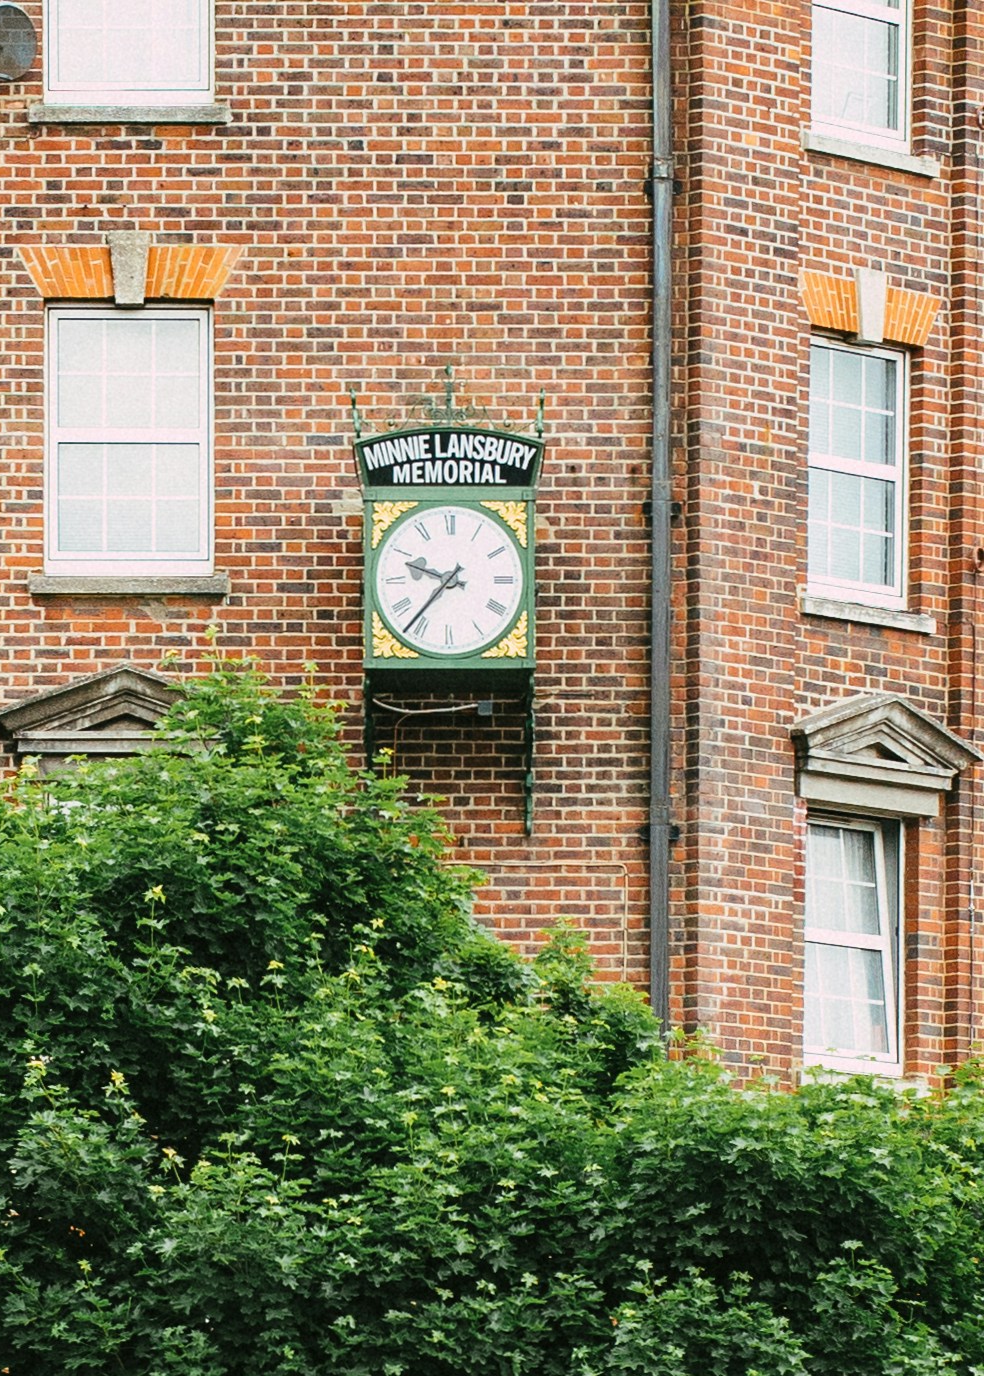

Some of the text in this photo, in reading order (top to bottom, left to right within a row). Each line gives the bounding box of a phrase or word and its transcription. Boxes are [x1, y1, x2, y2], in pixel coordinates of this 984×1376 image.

[363, 433, 537, 471] MINNIE LANSBURY
[393, 460, 507, 484] MEMORIAL
